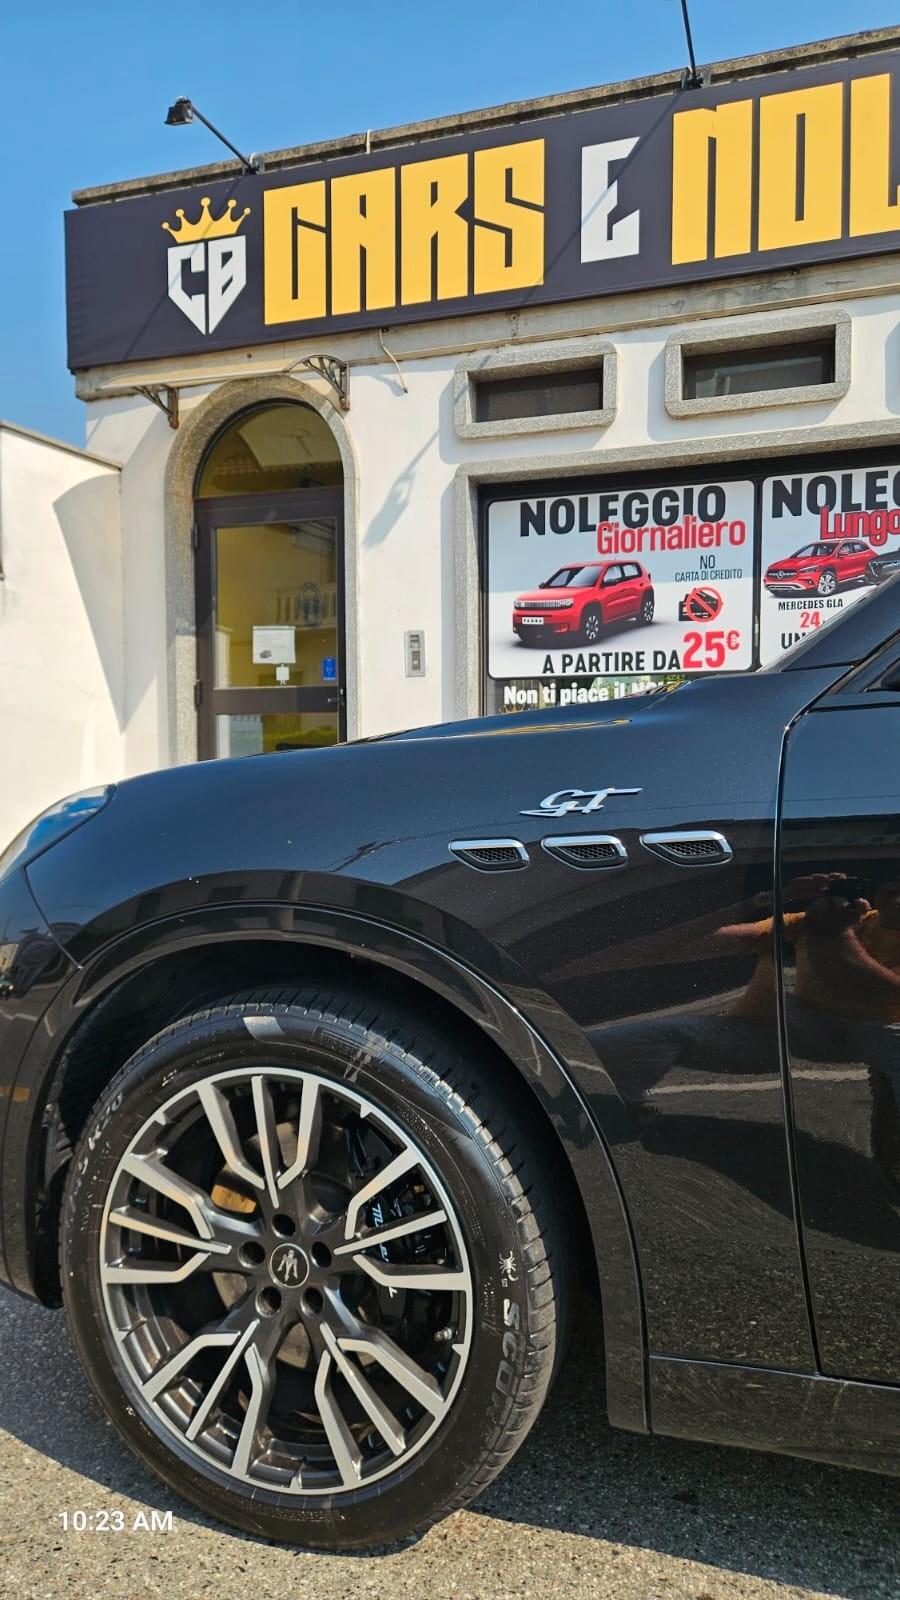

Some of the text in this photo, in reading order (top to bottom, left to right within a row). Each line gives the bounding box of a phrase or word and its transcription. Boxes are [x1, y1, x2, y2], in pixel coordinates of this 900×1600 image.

[264, 138, 546, 326] CARS
[581, 136, 640, 264] E
[772, 468, 900, 518] NOLE
[520, 485, 727, 537] NOLEGGIO
[597, 513, 746, 555] Giornaliero
[675, 568, 743, 582] CARTA DI CREDITO
[700, 555, 716, 570] NO
[778, 599, 843, 610] MERCEDES GLA
[800, 611, 821, 628] 24
[542, 630, 740, 673] A PARTIRE DA 25€
[504, 686, 537, 705] Non
[541, 682, 556, 703] ti
[560, 682, 609, 706] piace
[614, 682, 626, 699] il
